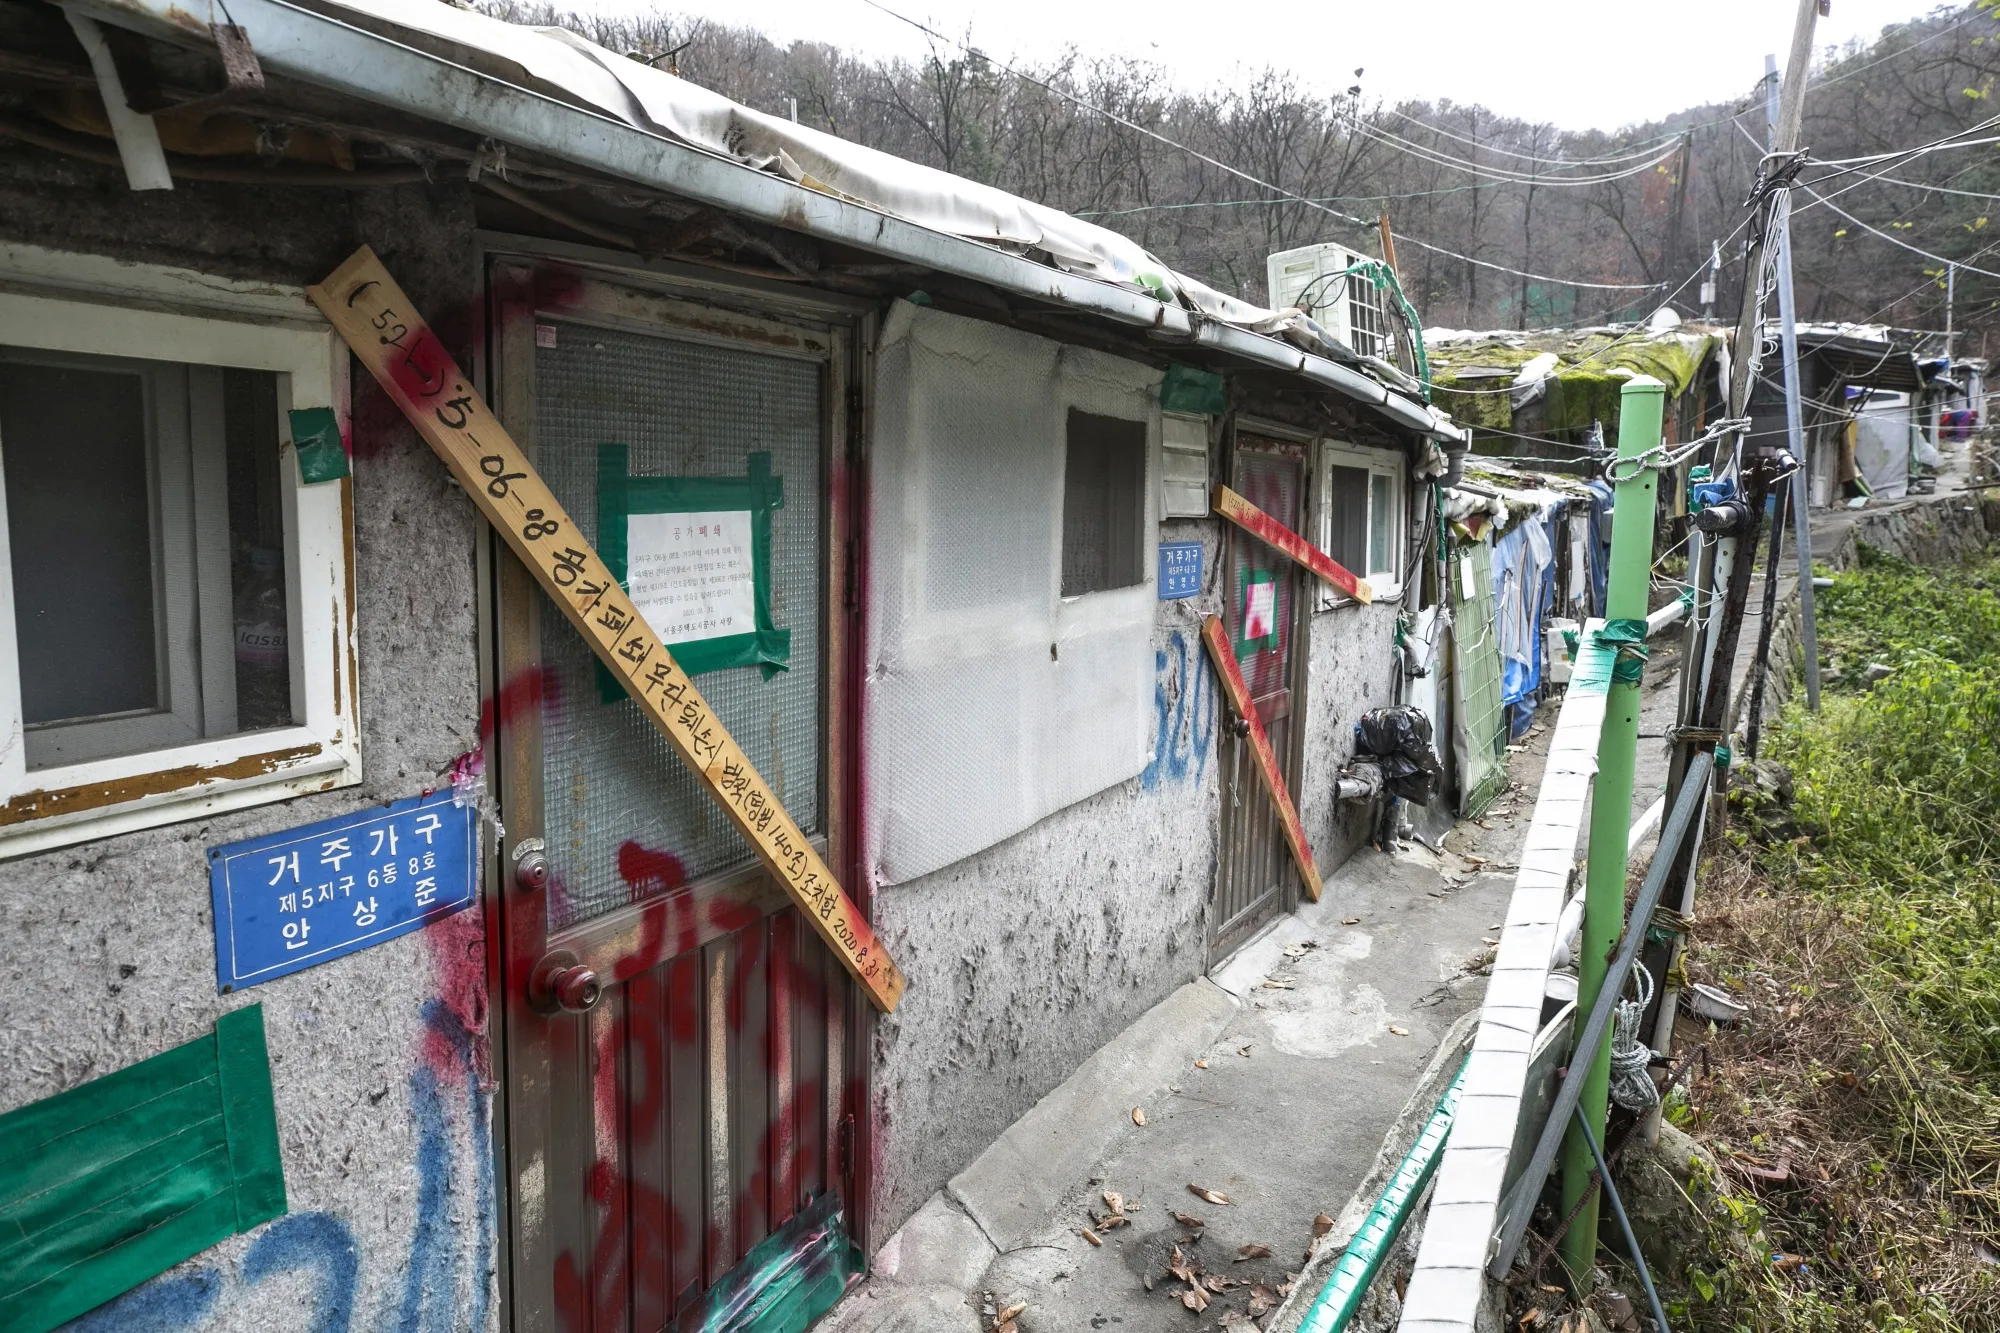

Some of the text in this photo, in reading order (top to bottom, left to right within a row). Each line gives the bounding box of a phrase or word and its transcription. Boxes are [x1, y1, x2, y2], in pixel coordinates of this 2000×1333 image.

[663, 616, 733, 636] 서울주택도시공사 사장
[268, 813, 442, 887] 거주가구
[279, 851, 437, 914] 제5지구 6동 8호
